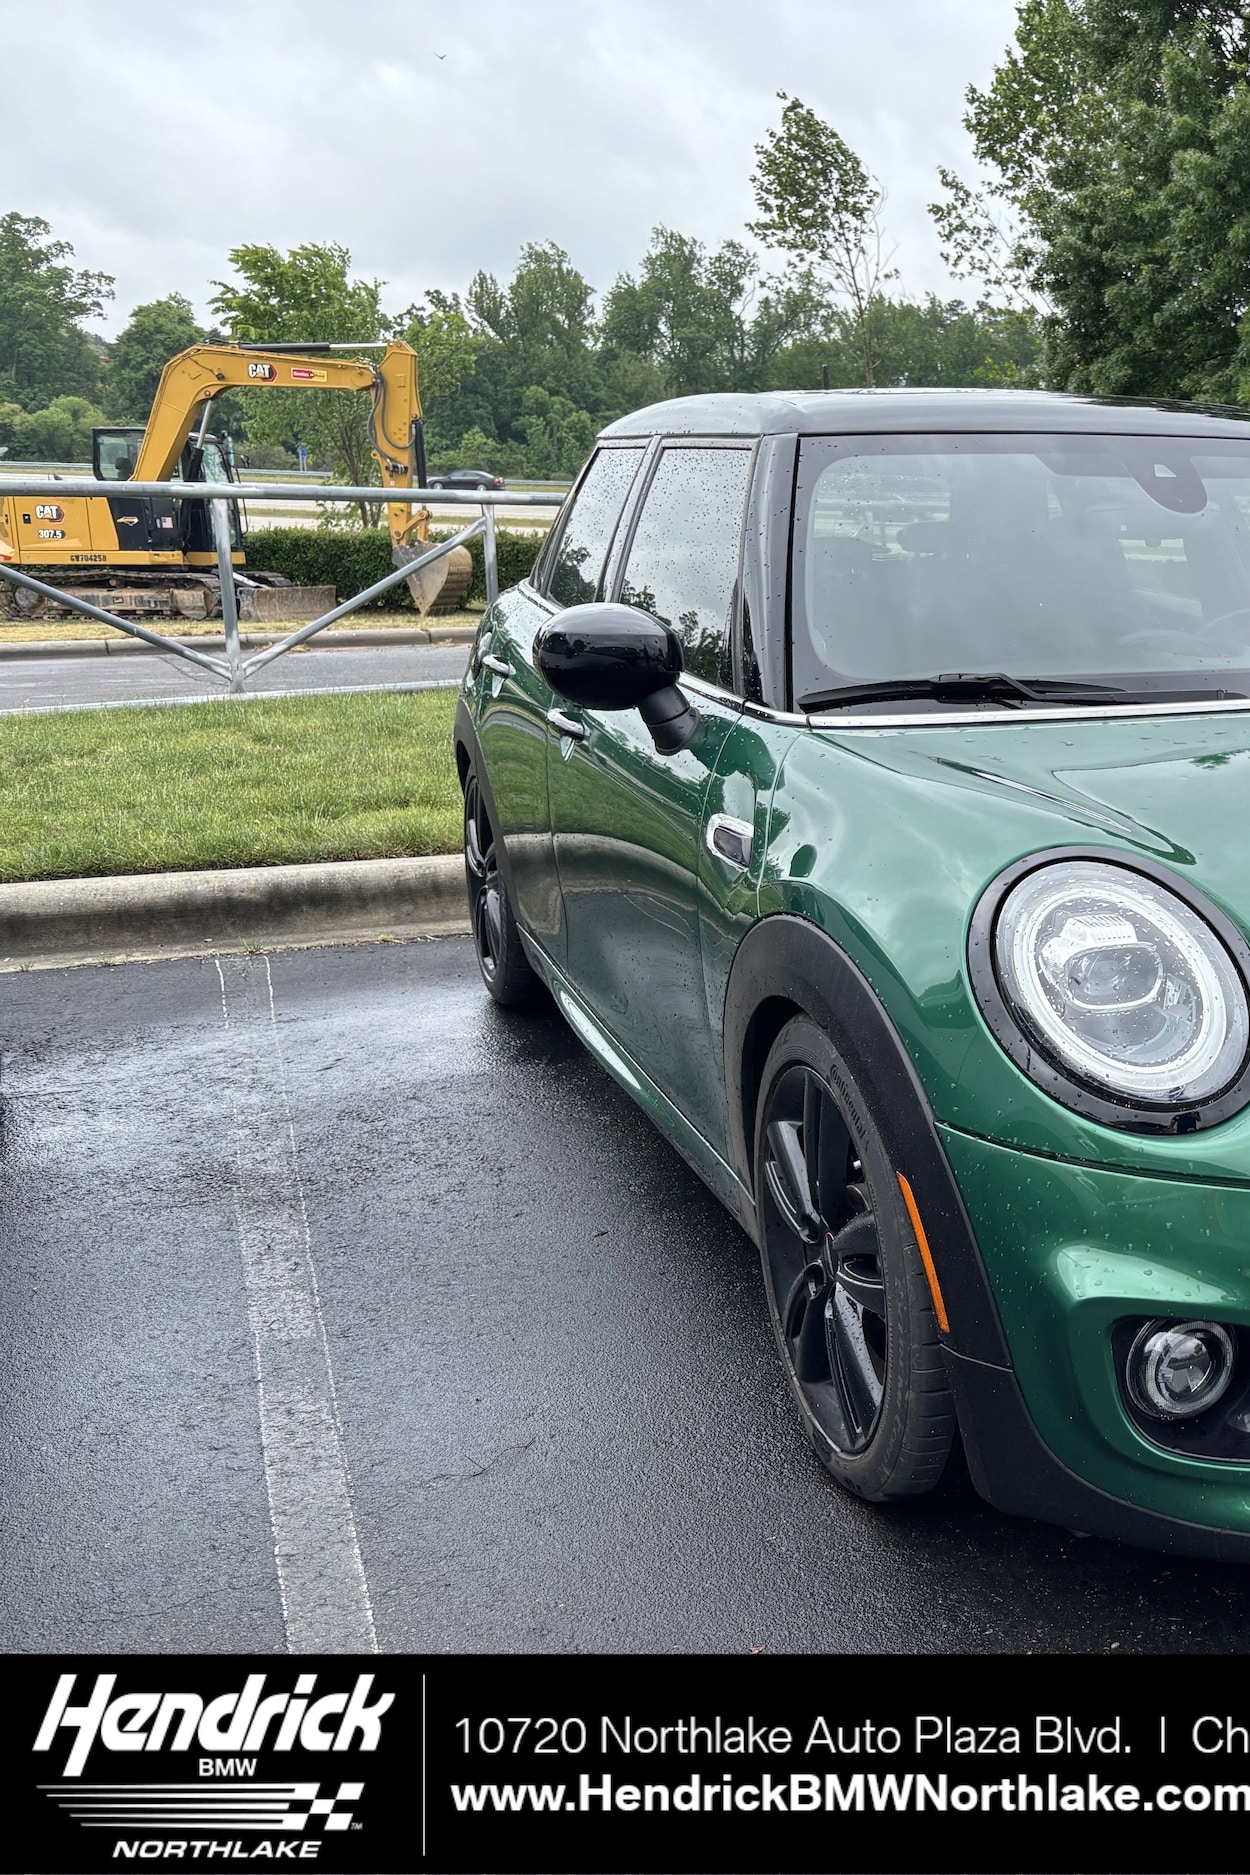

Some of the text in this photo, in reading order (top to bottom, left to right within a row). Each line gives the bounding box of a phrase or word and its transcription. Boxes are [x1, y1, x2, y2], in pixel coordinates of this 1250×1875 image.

[248, 363, 271, 378] CAT
[35, 505, 58, 519] CAT
[38, 529, 62, 539] 307.5
[829, 1063, 868, 1140] Continental
